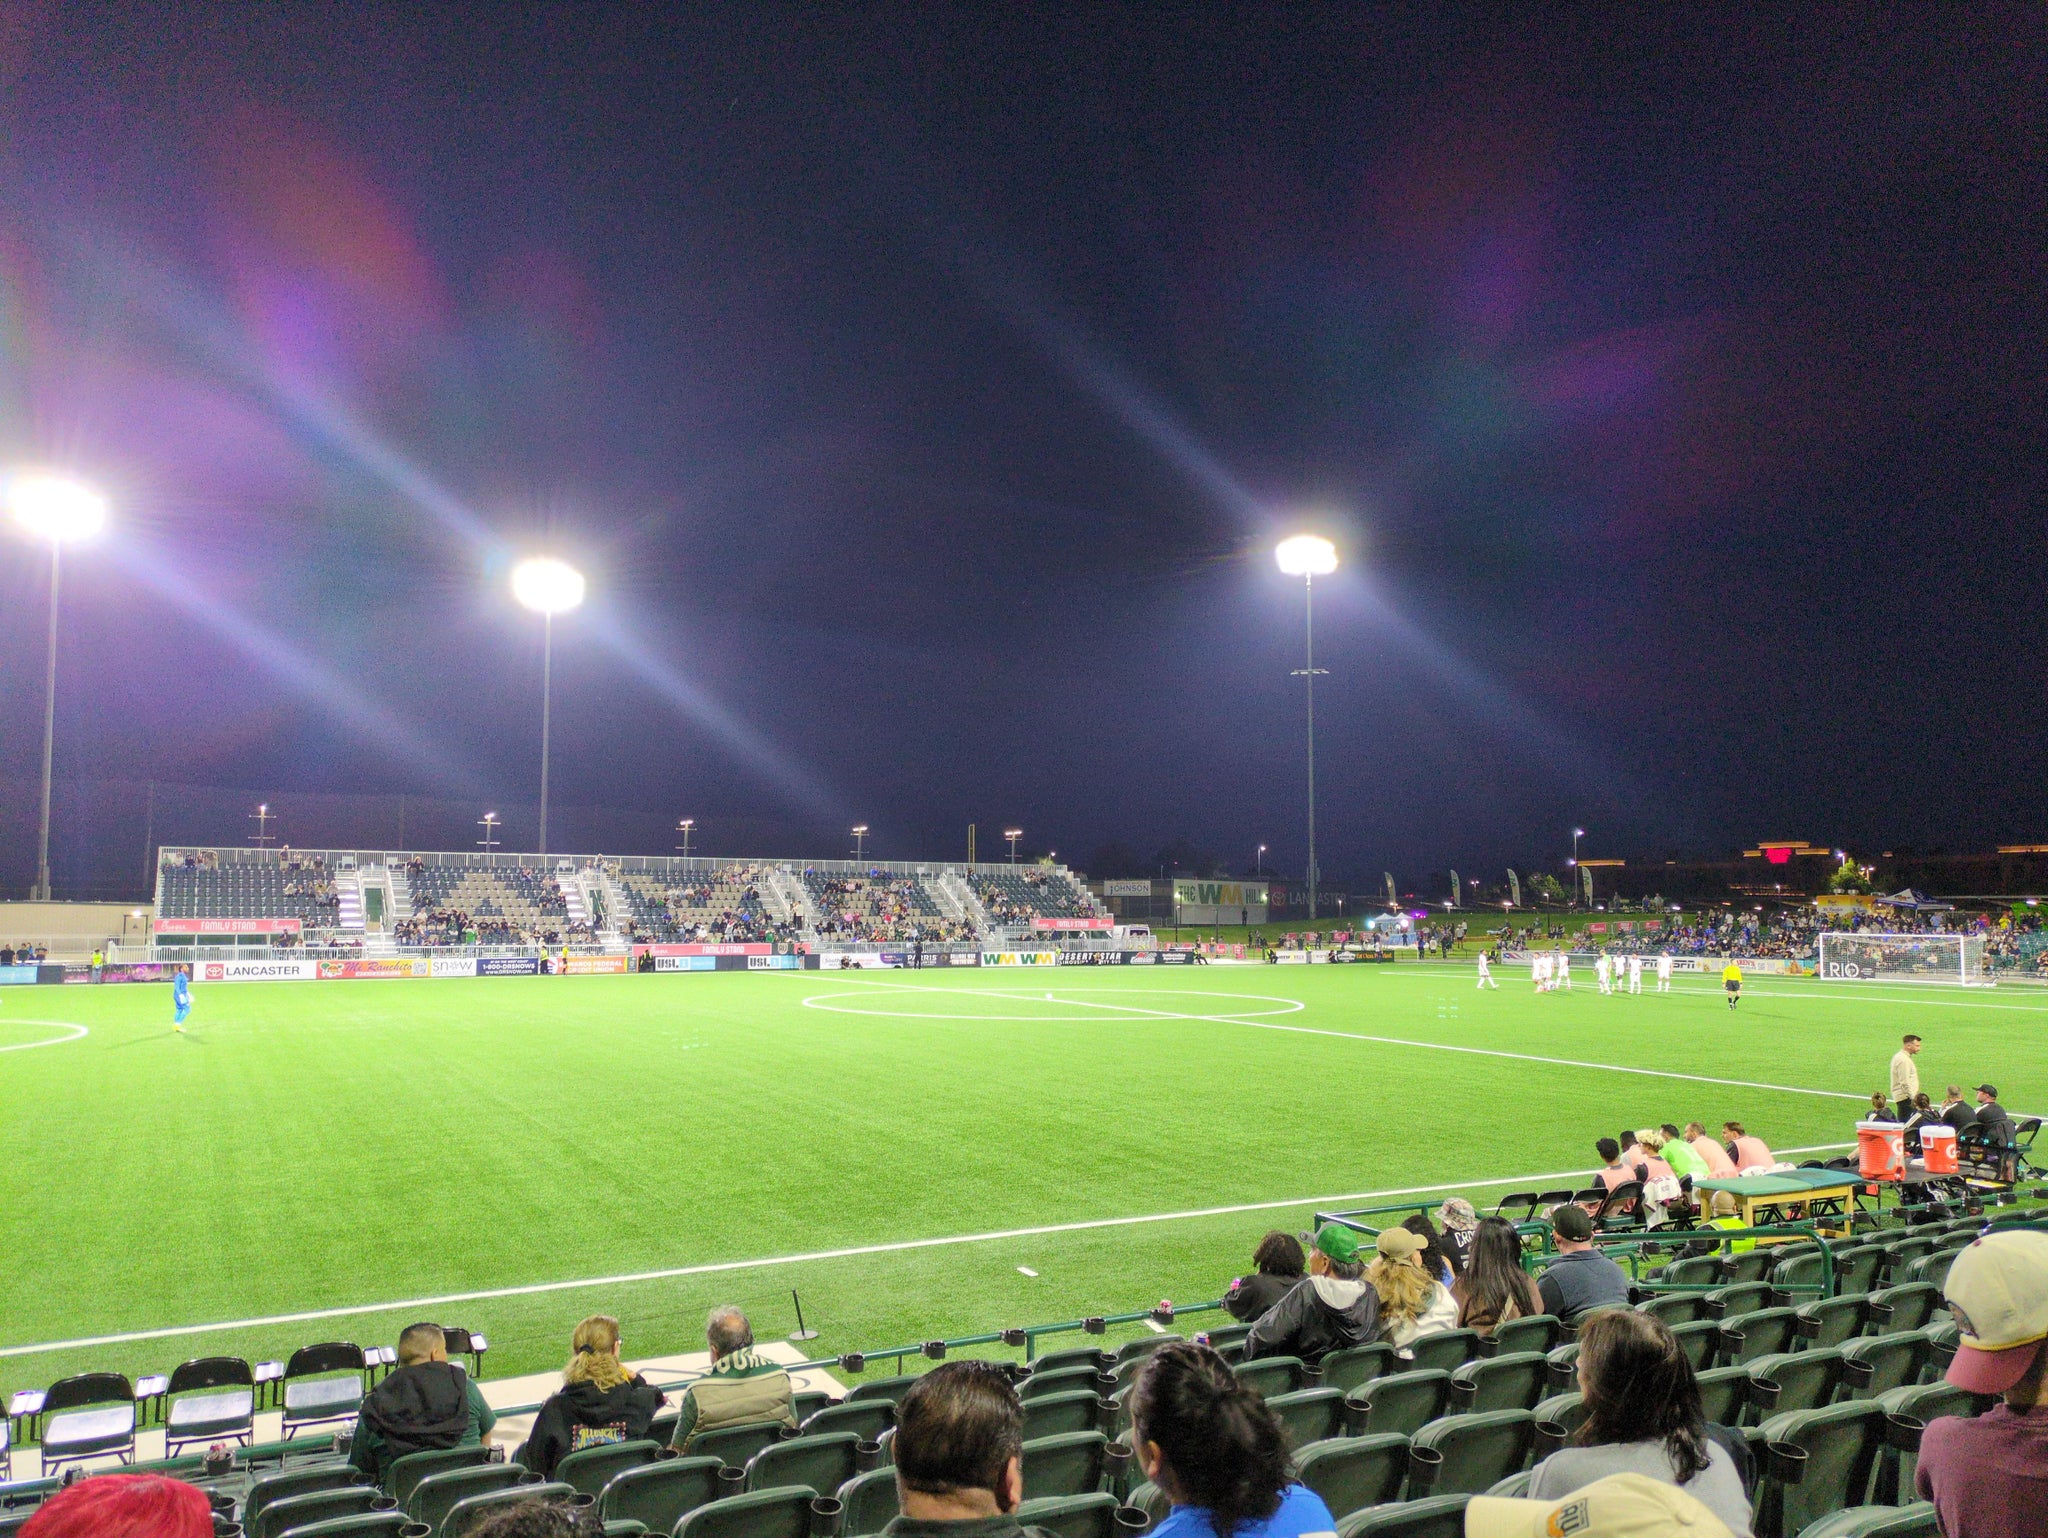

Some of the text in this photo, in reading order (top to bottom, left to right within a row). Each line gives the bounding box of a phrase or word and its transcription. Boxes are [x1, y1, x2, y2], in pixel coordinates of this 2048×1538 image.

[1178, 885, 1196, 902] THE
[1198, 883, 1244, 905] WM
[1289, 892, 1347, 905] LANASTER
[200, 921, 257, 931] FAMILY STAND
[702, 945, 745, 954] FAMILY STAND
[983, 953, 1017, 965] WM
[1020, 953, 1053, 965] WM
[1059, 952, 1094, 960] DESERT
[1100, 952, 1122, 960] STAR
[226, 966, 300, 976] LANCASTER
[366, 960, 412, 972] Ranchito
[1829, 962, 1859, 978] RIO
